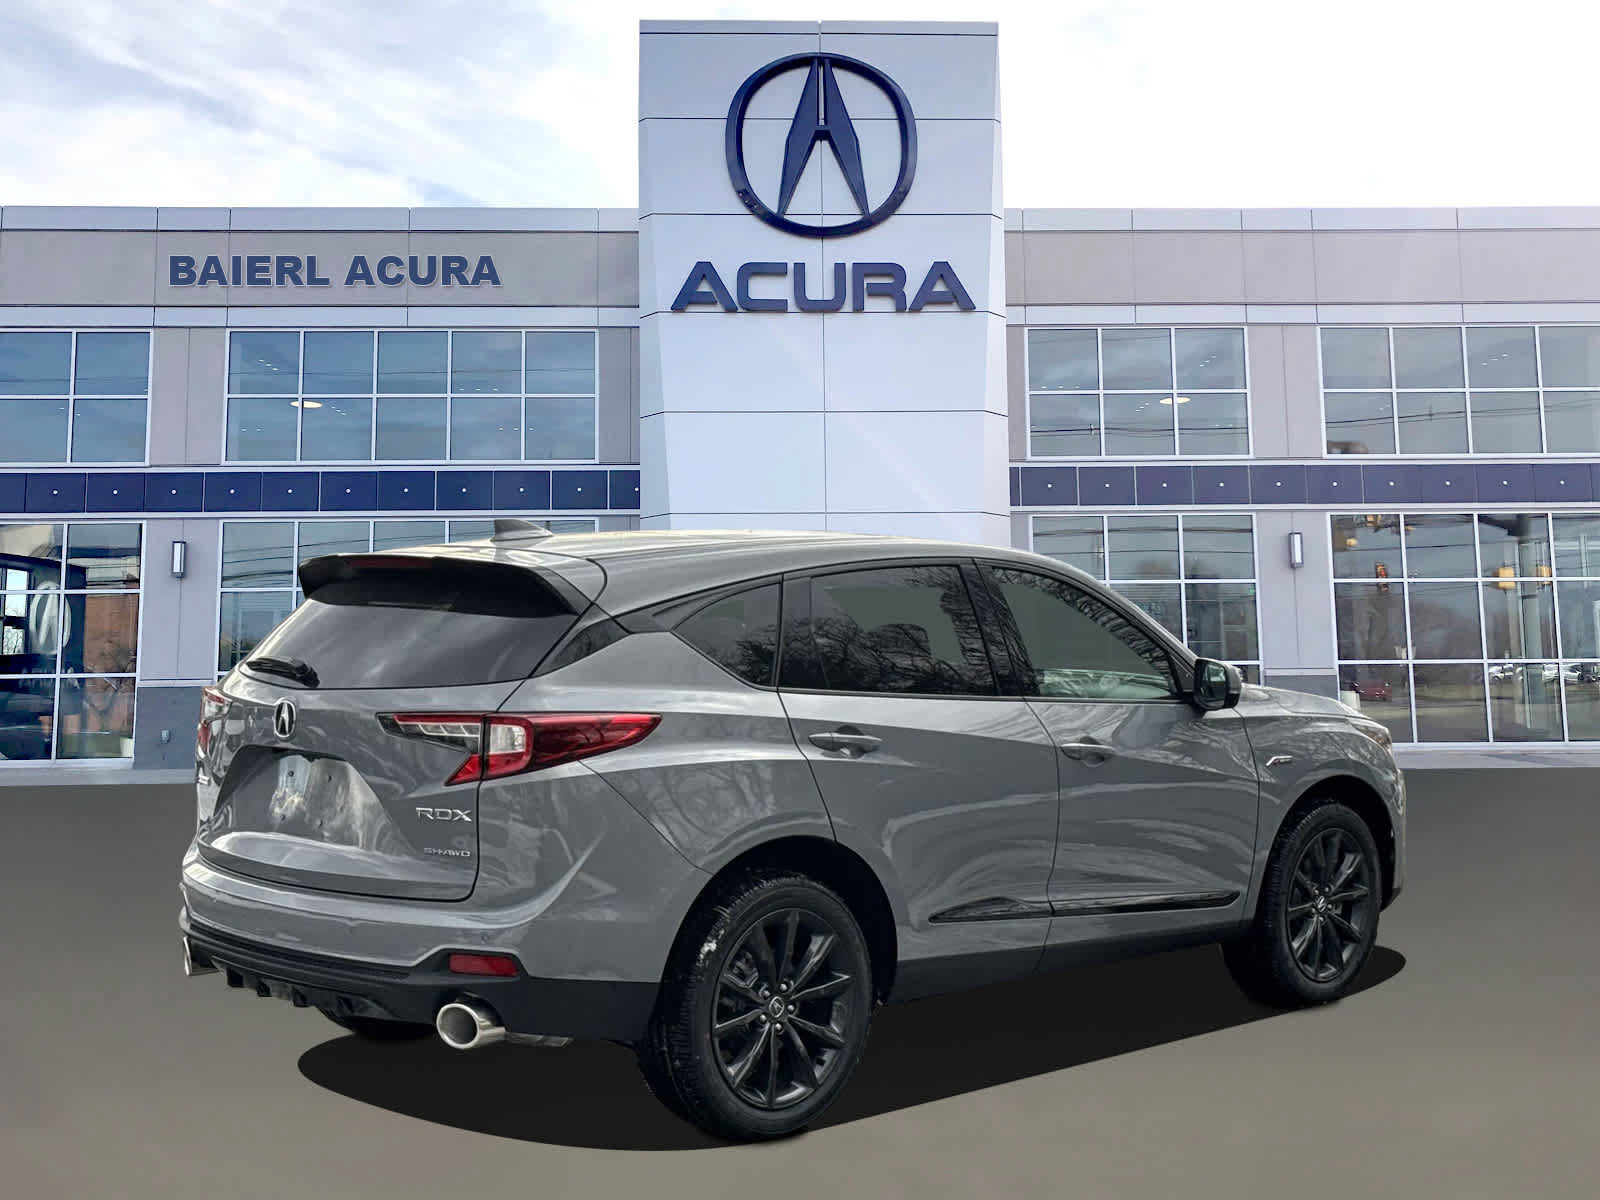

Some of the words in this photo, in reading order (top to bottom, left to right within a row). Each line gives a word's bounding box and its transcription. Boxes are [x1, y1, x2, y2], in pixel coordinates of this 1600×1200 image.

[168, 255, 331, 287] BAIERL
[343, 255, 502, 287] ACURA
[670, 260, 977, 313] ACURA
[415, 807, 472, 822] RDX
